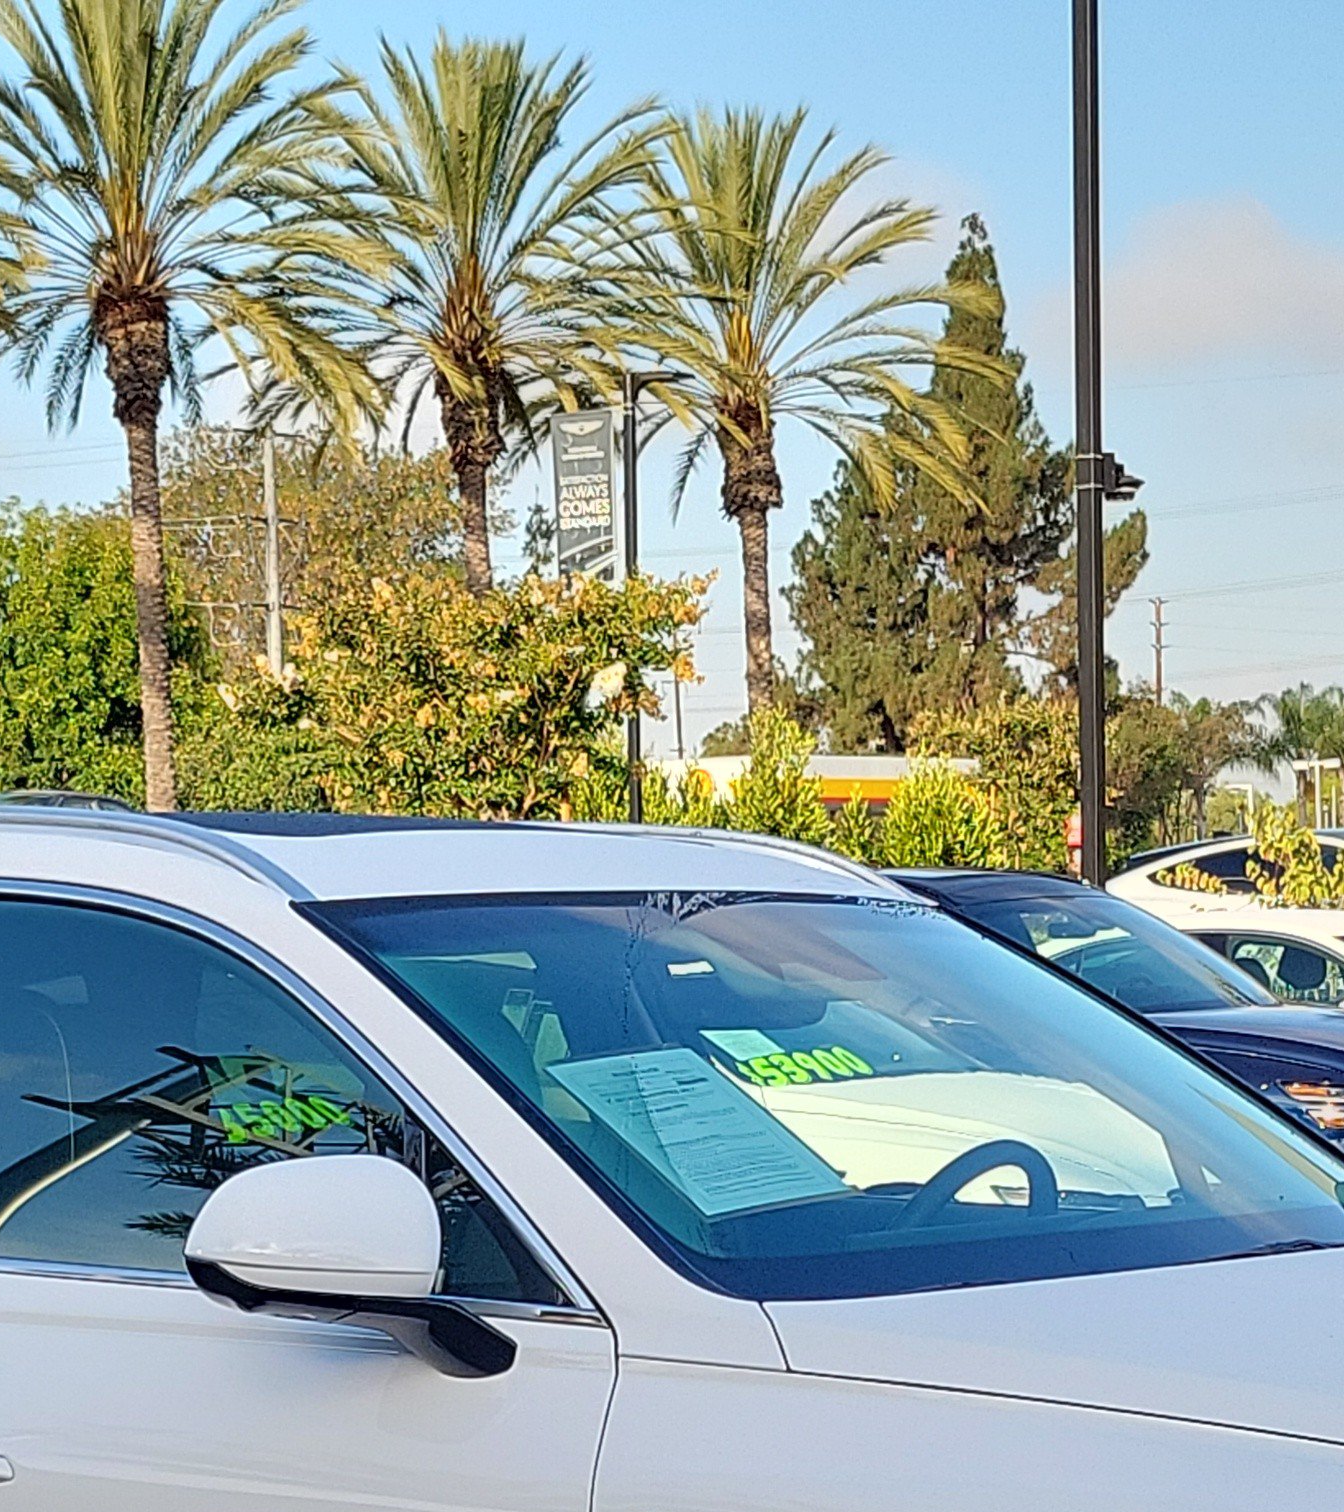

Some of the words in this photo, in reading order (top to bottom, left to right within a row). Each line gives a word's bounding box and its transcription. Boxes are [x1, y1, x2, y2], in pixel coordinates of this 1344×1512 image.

[560, 485, 609, 501] ALWAYS
[559, 500, 611, 518] COMES
[735, 1047, 874, 1087] $53900
